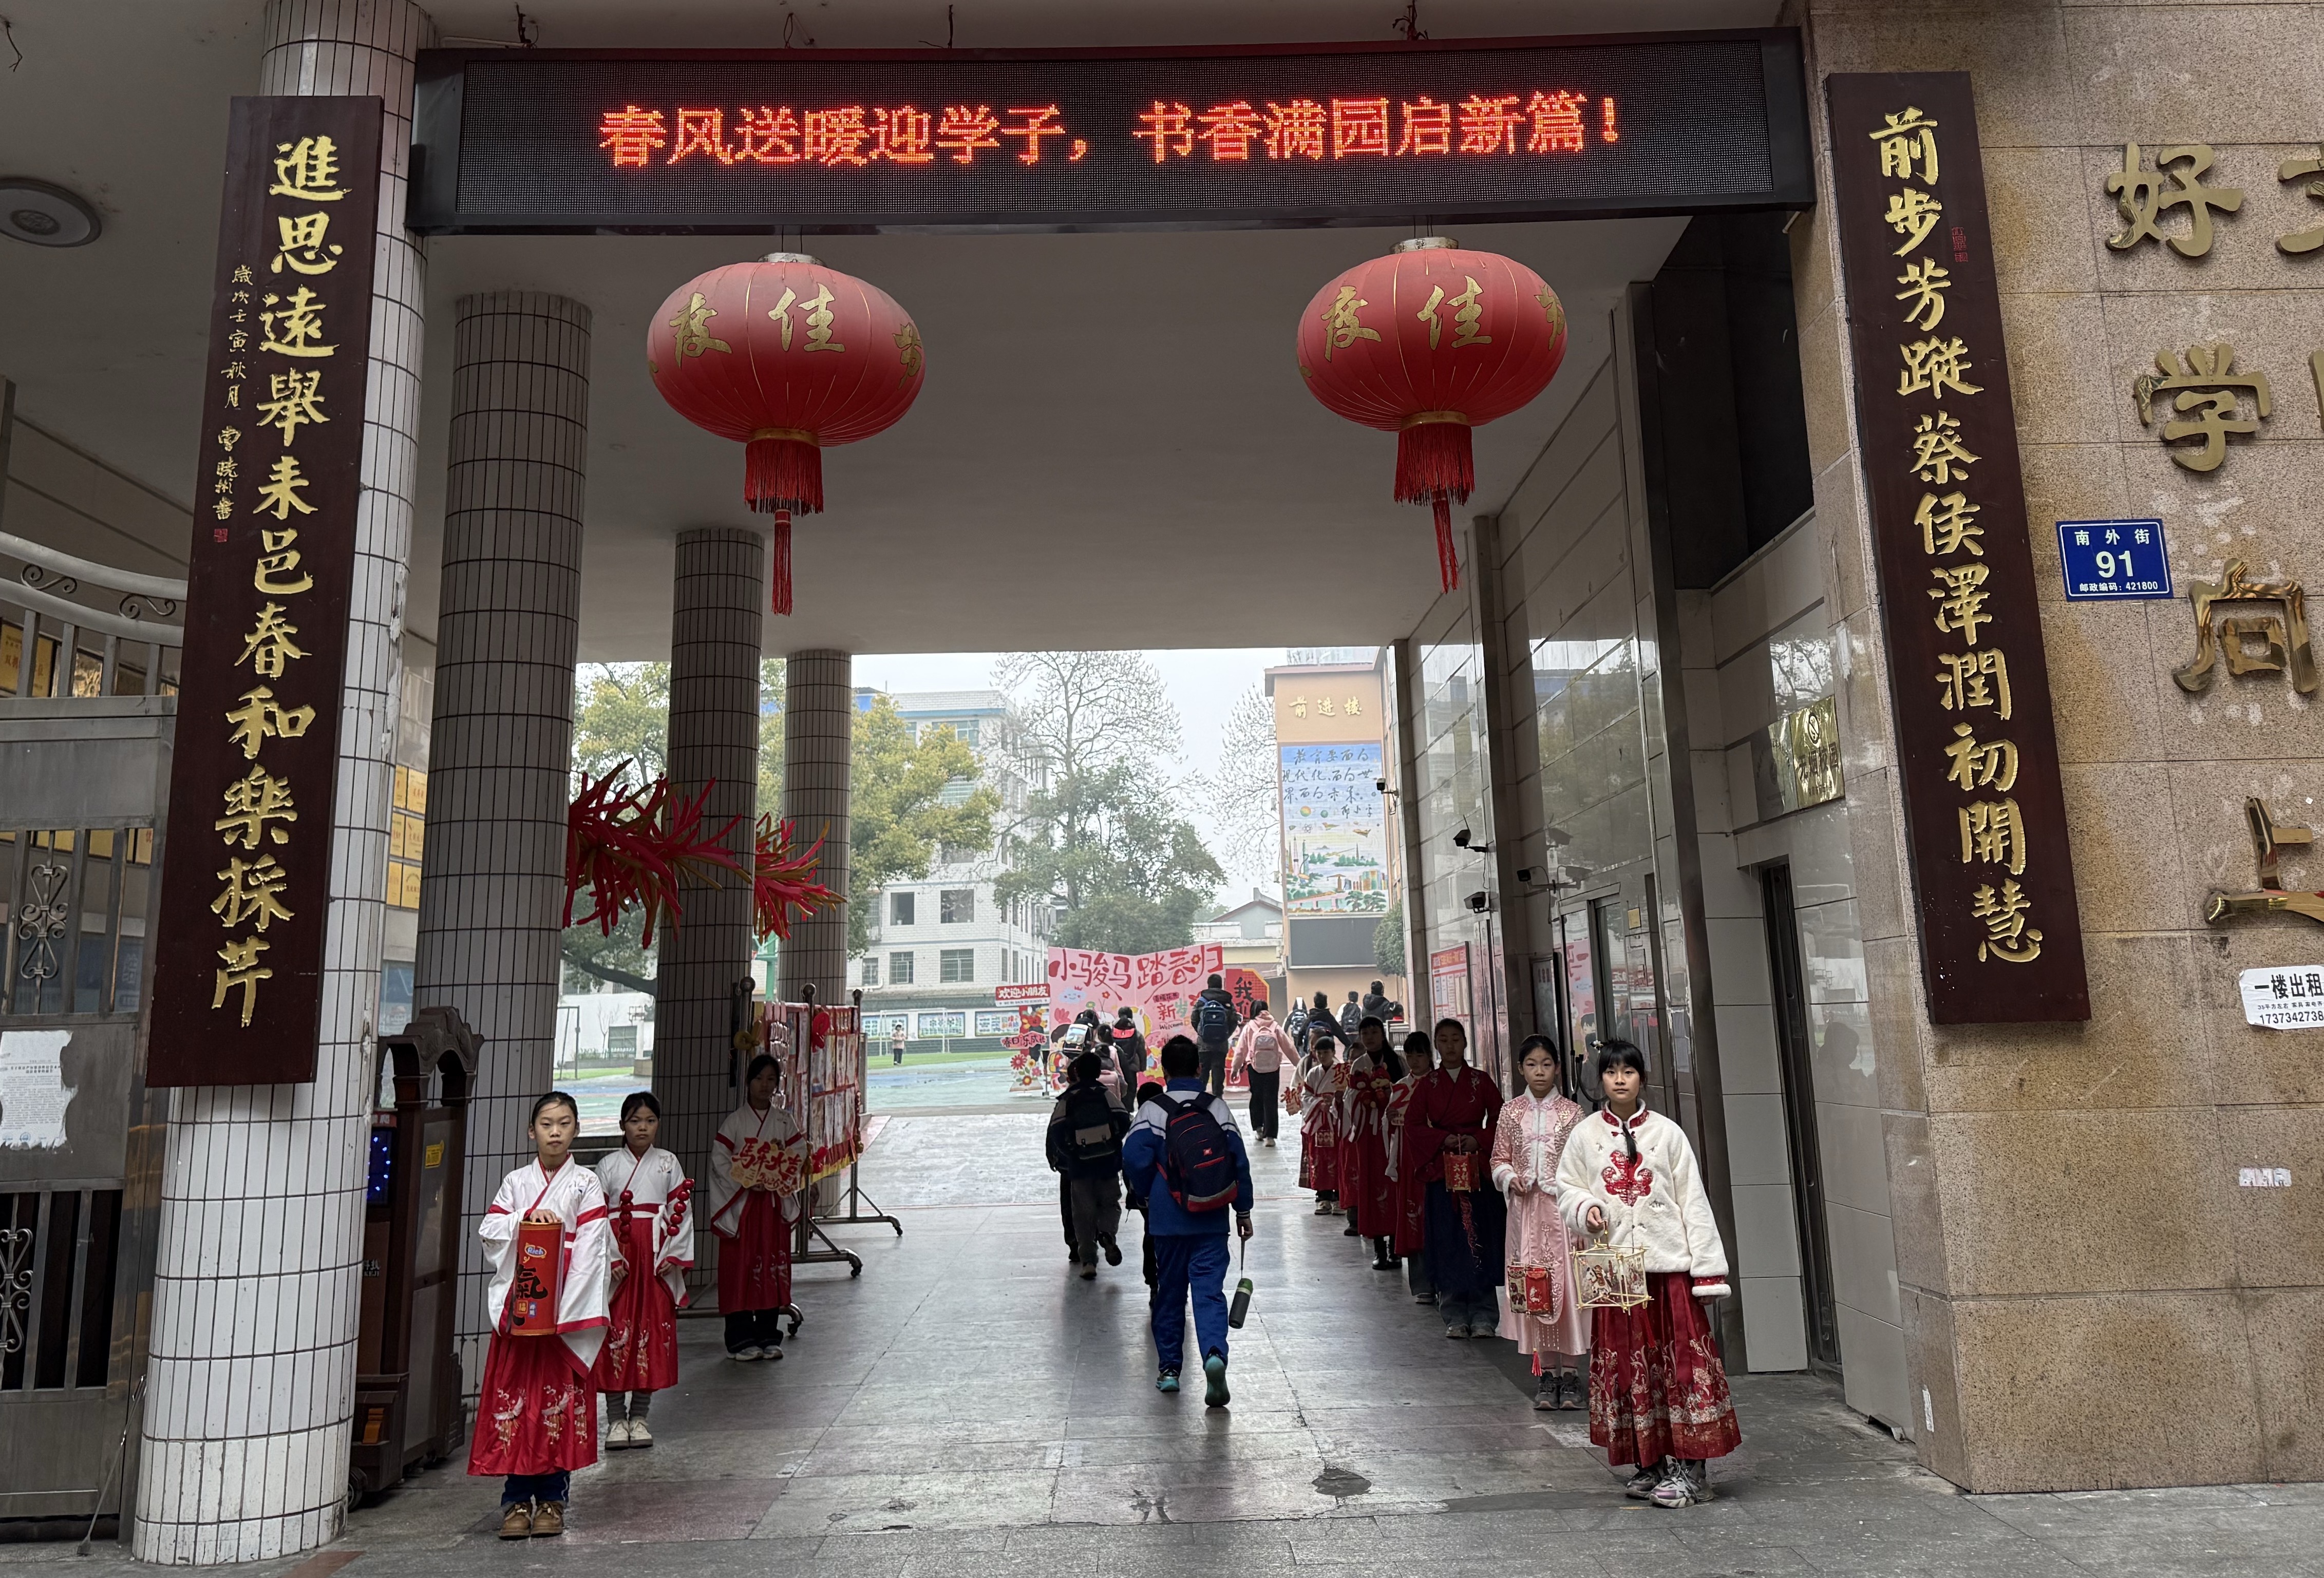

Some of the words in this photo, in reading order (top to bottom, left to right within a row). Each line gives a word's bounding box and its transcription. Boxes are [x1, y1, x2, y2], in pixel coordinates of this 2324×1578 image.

[2074, 528, 2149, 545] 南外街
[2096, 550, 2133, 578] 91
[1288, 695, 1362, 719] 前进楼
[998, 985, 1049, 999] 欢迎小朋友
[2254, 973, 2324, 999] 一楼出租
